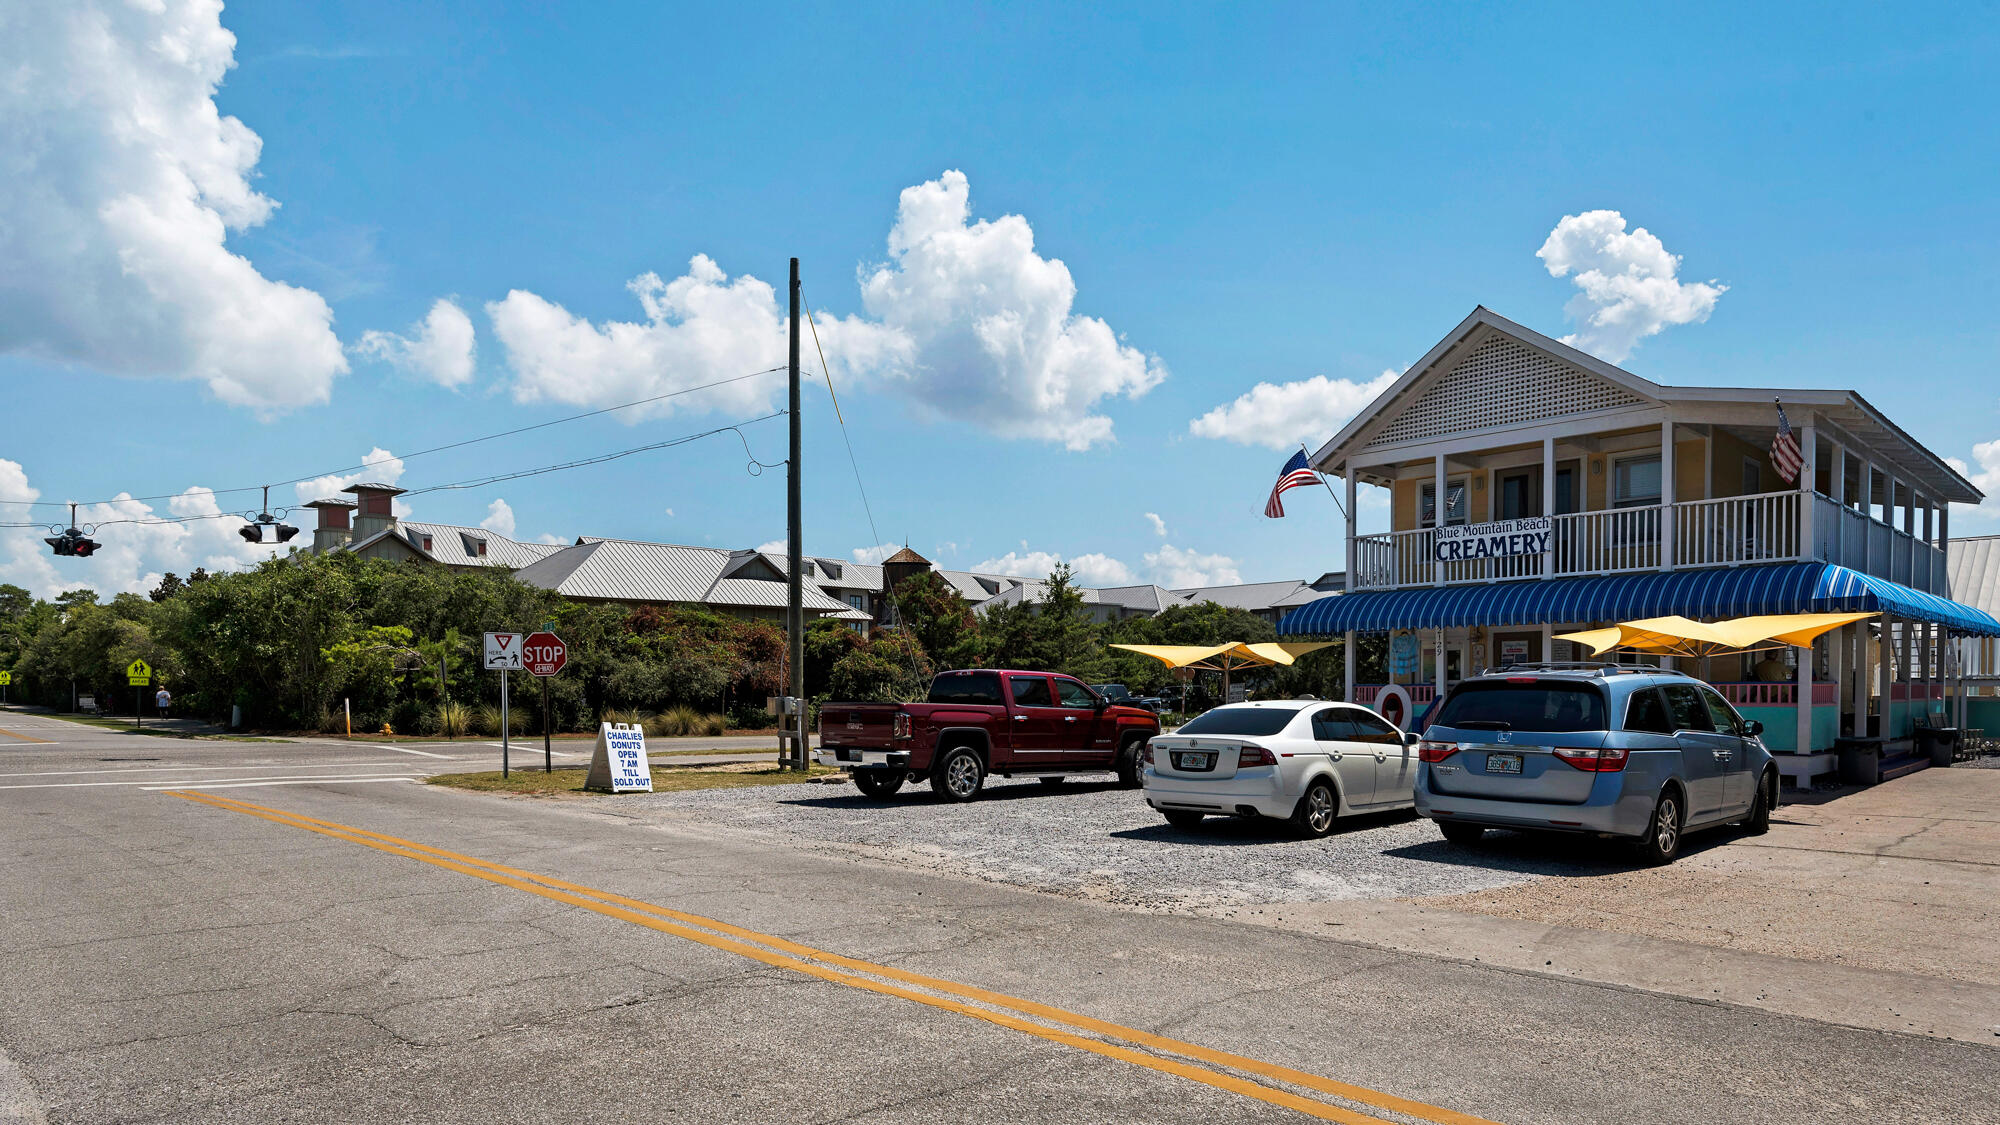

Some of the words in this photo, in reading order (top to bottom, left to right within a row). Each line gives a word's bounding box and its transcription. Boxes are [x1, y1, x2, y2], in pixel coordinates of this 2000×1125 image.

[1437, 528, 1459, 539] Blue
[1462, 521, 1512, 536] Mountain
[1516, 518, 1549, 531] Beach
[1436, 531, 1551, 561] CREAMERY
[524, 646, 563, 662] STOP
[536, 665, 553, 673] 4-WAY
[607, 732, 642, 740] CHARLIES
[611, 741, 641, 749] DONUTS
[622, 769, 639, 777] TILL
[614, 777, 633, 786] SOLD
[635, 778, 650, 786] OUT
